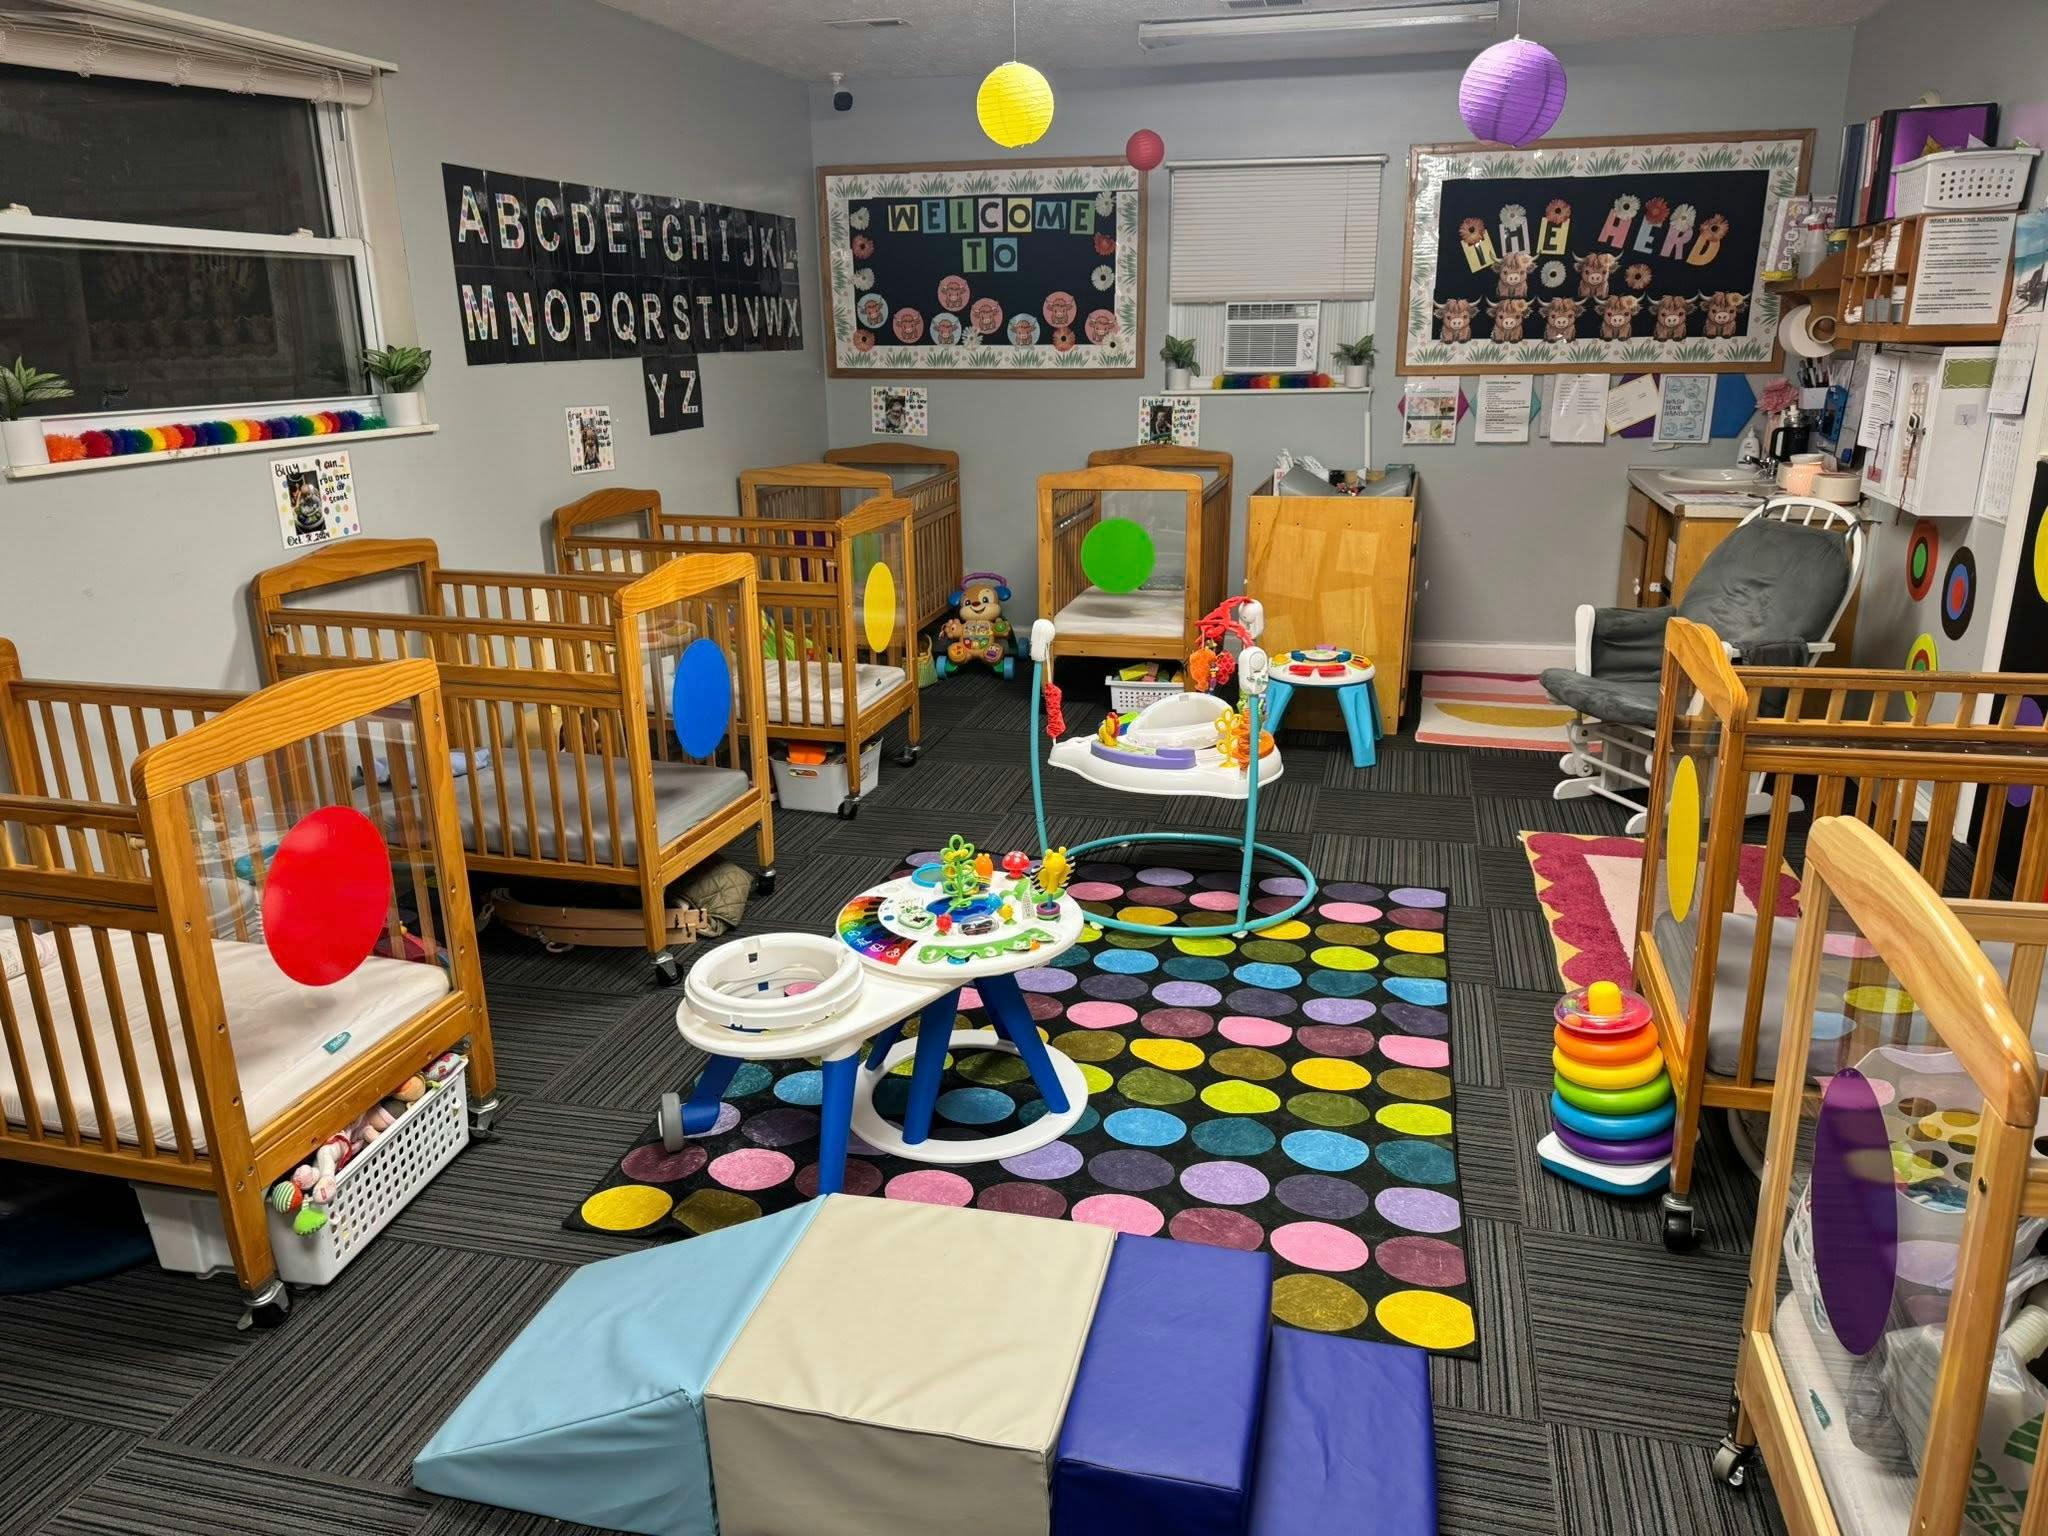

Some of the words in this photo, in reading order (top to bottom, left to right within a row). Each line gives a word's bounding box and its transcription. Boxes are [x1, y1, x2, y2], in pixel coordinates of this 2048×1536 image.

[459, 185, 488, 244] A
[495, 193, 525, 249] B
[535, 197, 560, 252] C
[570, 203, 595, 254] D
[604, 204, 627, 253] E
[636, 211, 653, 259] F
[662, 215, 684, 262] G
[689, 215, 709, 262] H
[719, 220, 731, 262] I
[743, 225, 754, 267] J
[761, 227, 777, 268] K
[781, 230, 795, 270] L
[889, 201, 1090, 232] WELCOME
[1597, 208, 1721, 266] HERD
[966, 241, 1017, 271] TO
[462, 285, 498, 341] M
[506, 291, 535, 345] N
[544, 289, 570, 342] O
[580, 291, 601, 341] P
[611, 291, 636, 344] Q
[642, 293, 664, 340] R
[672, 294, 691, 341] S
[696, 296, 713, 339] T
[721, 293, 739, 337] U
[744, 297, 759, 338] V
[763, 297, 784, 336] W
[786, 298, 801, 337] X
[648, 373, 668, 419] Y
[680, 370, 698, 414] Z
